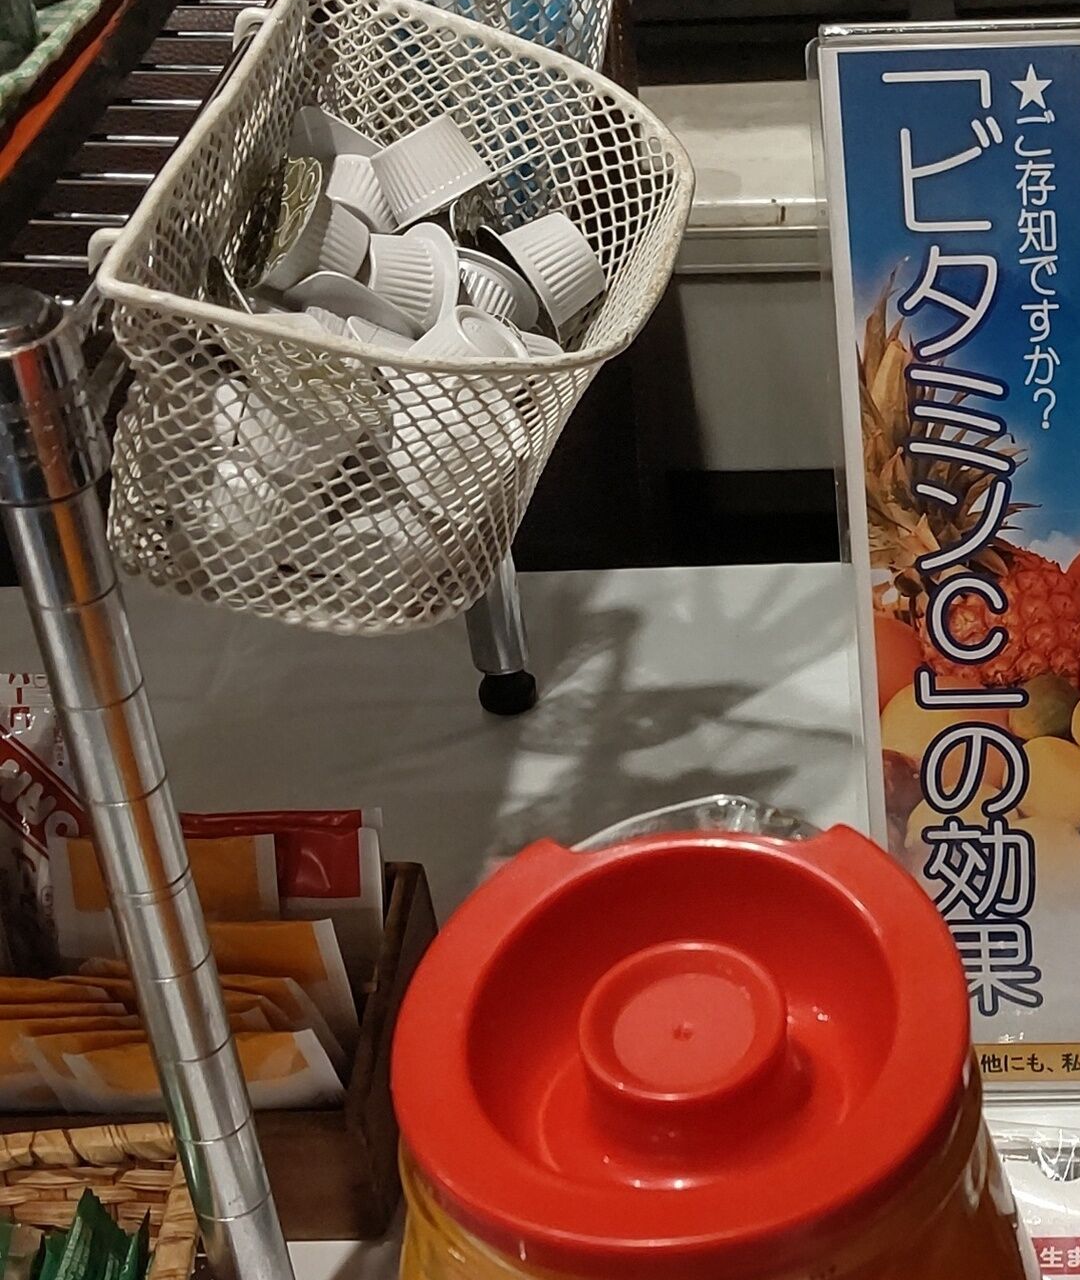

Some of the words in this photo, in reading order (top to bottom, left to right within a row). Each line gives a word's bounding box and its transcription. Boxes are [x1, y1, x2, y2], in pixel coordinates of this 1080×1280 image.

[882, 68, 1043, 1015] 「ビタミンC」の効果
[1013, 109, 1061, 430] ご存知ですか？
